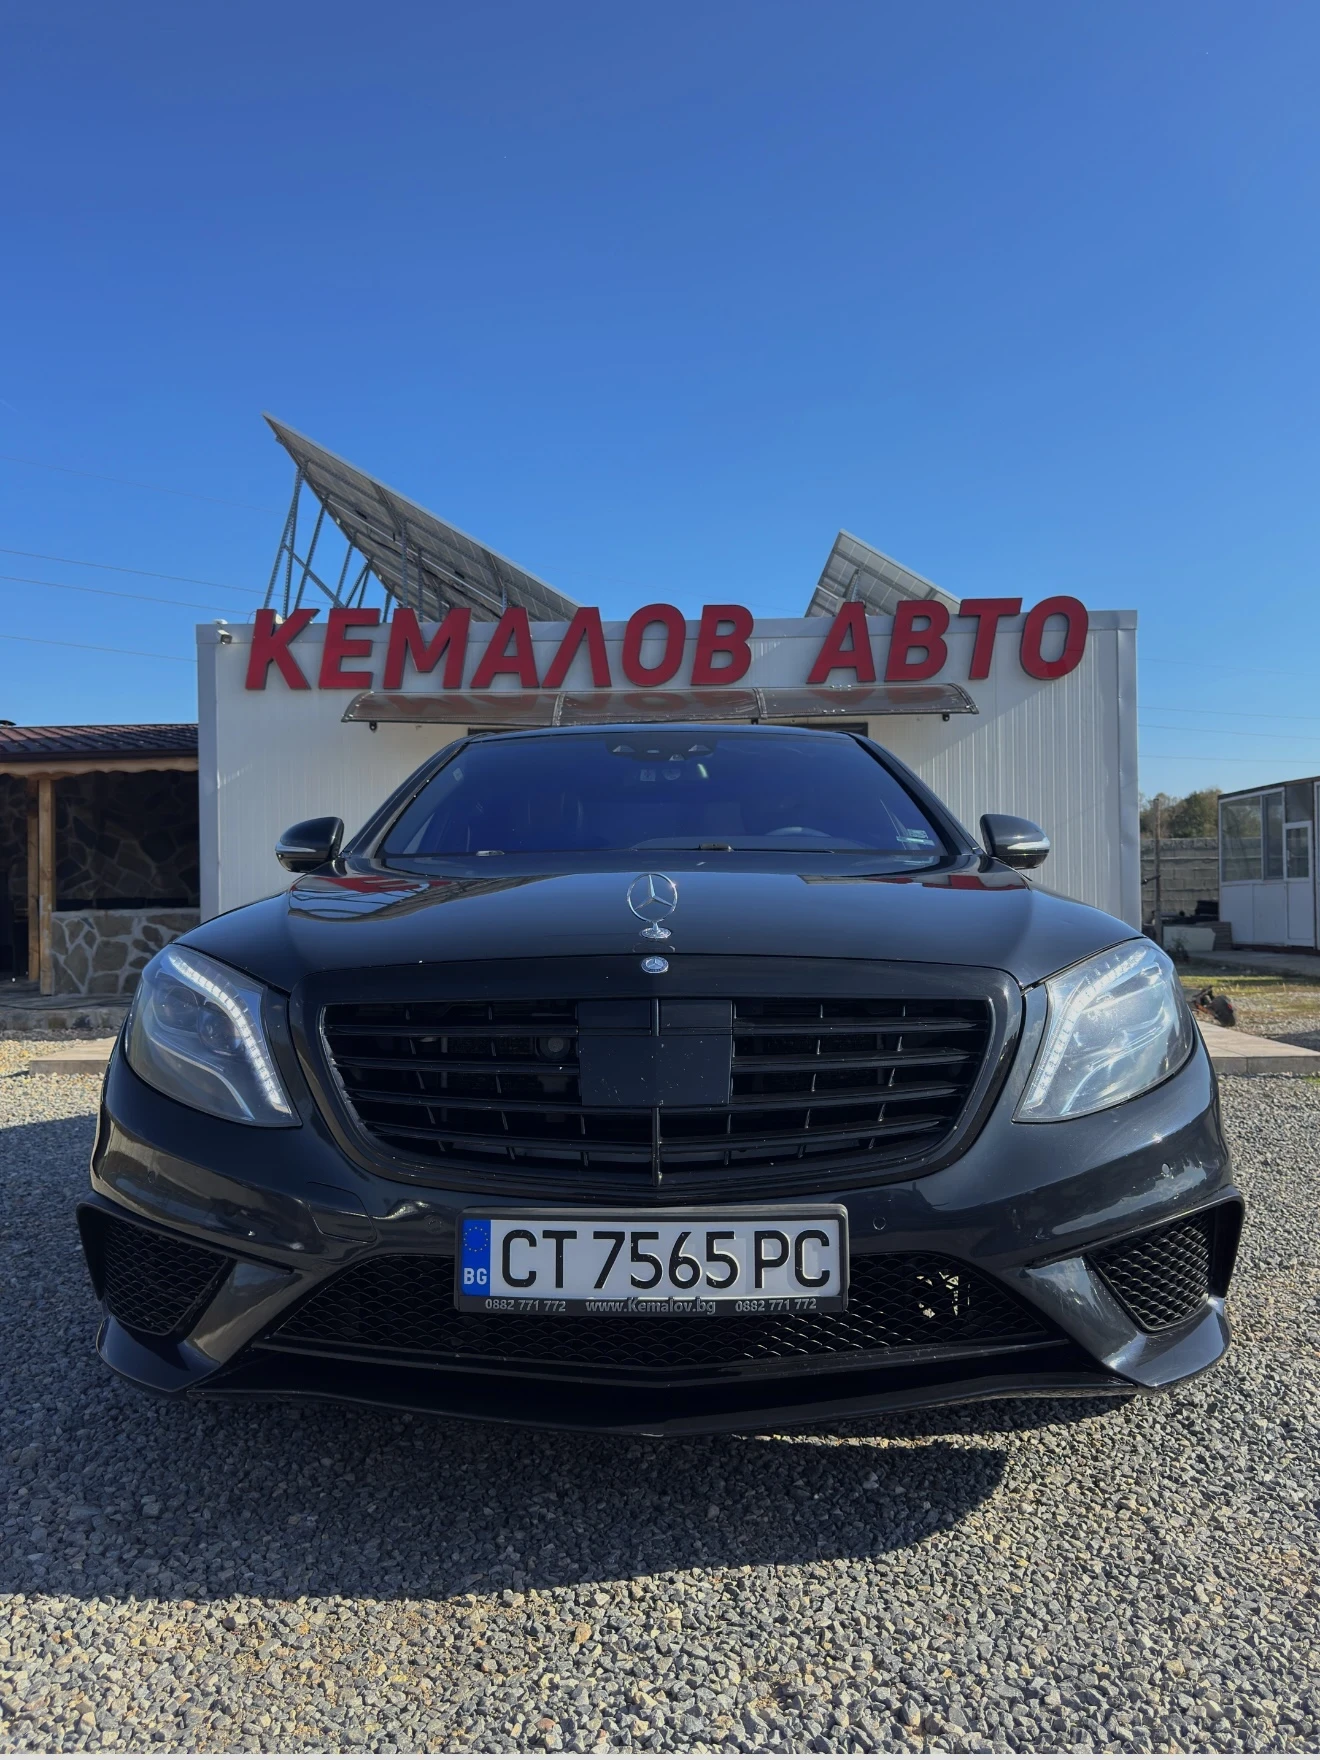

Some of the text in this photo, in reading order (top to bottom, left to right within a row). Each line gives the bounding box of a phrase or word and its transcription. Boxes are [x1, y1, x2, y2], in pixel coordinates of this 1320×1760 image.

[245, 595, 1089, 690] КЕМАЛОВ АВТО
[463, 1267, 488, 1285] BG
[502, 1229, 830, 1289] CT 7565 PC
[485, 1297, 817, 1315] 0882 771 772 www.Kemalov.bg 0882 771 772
